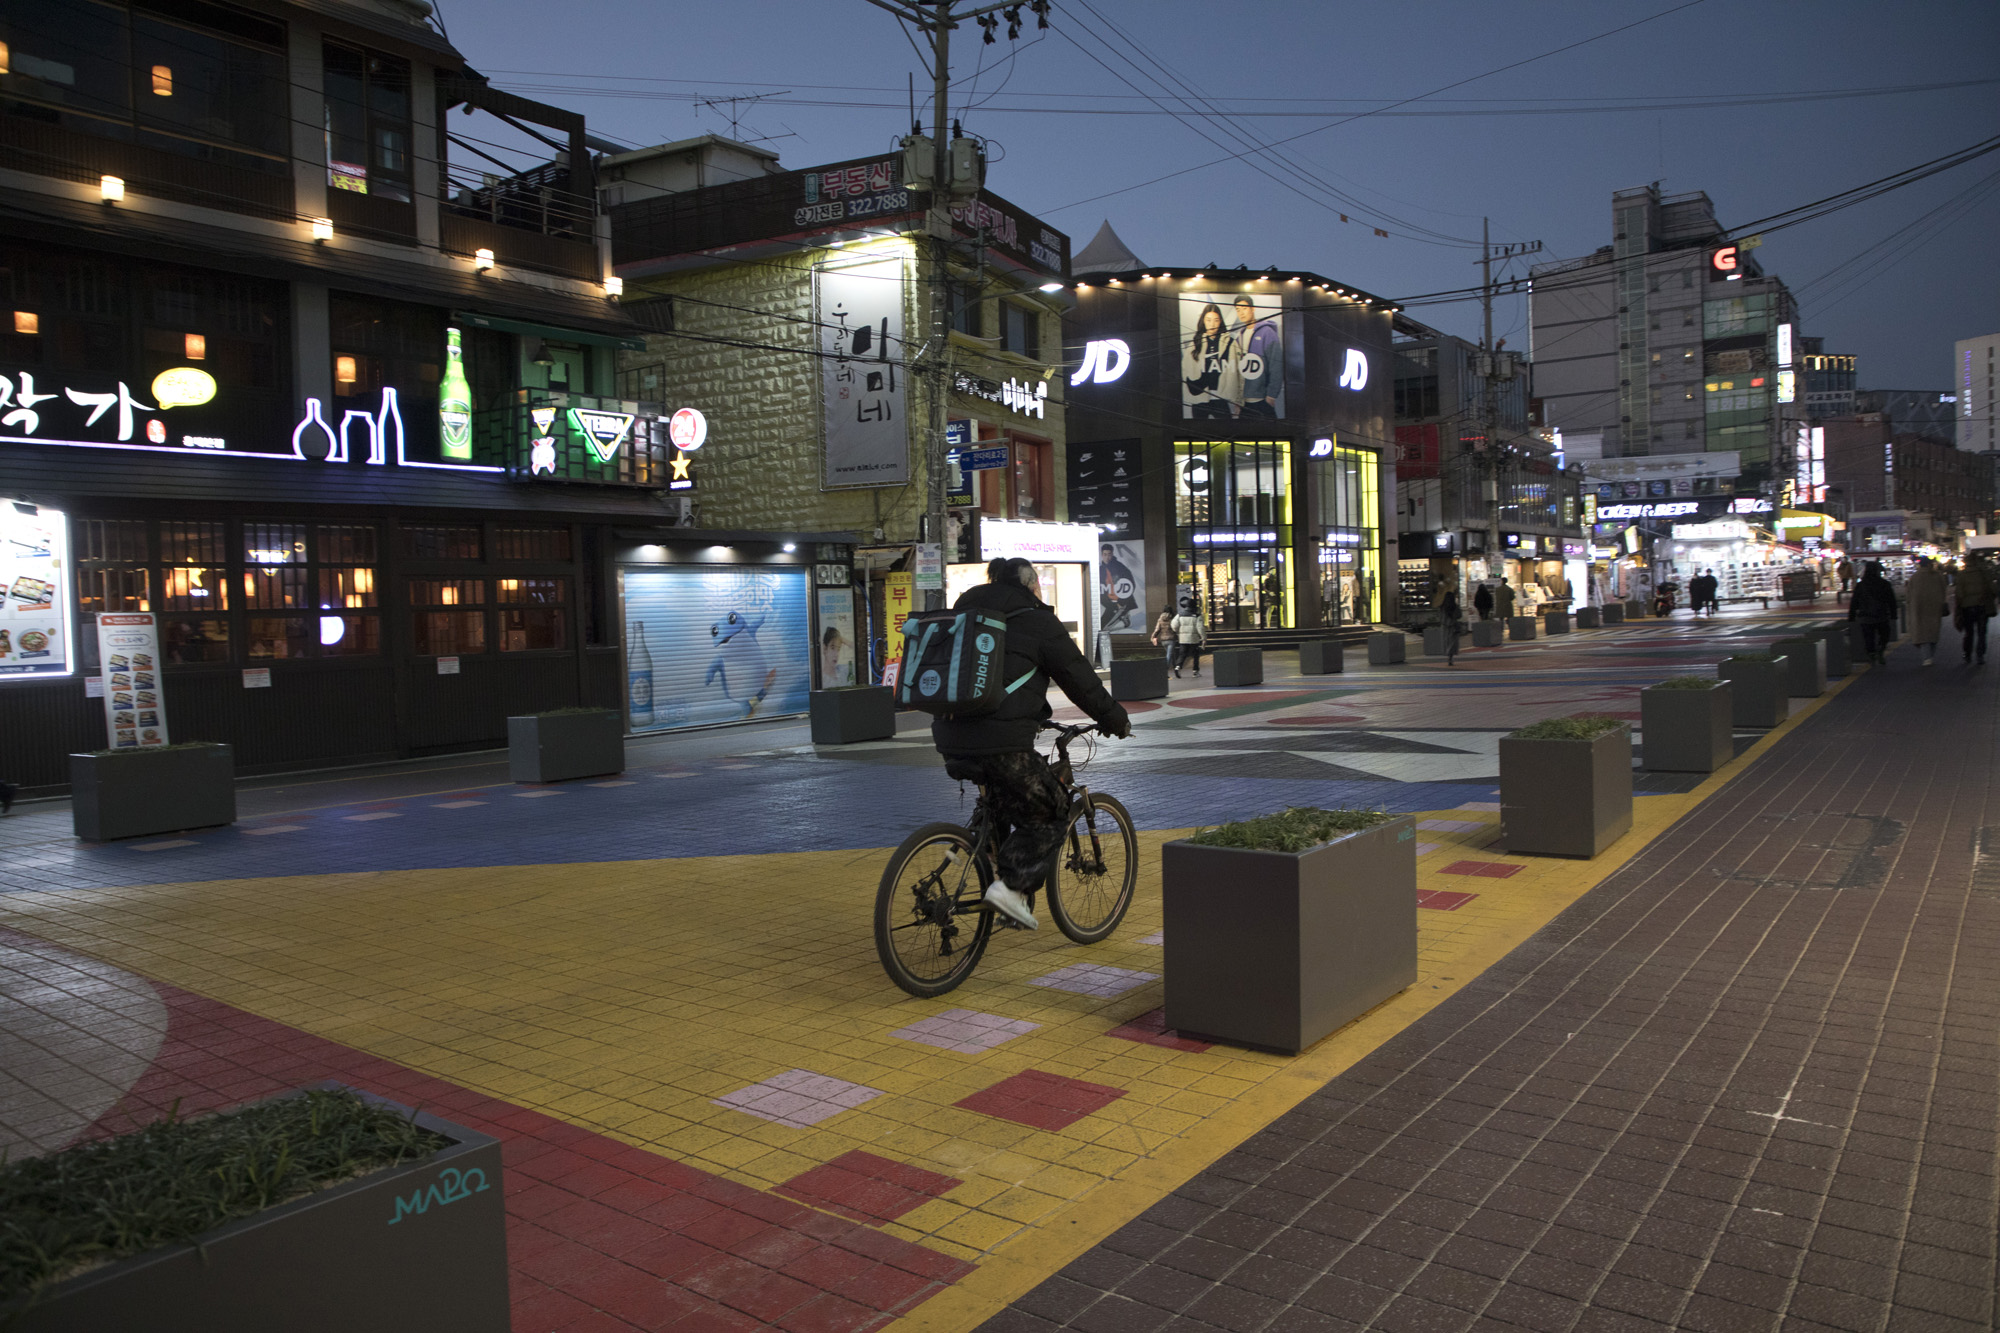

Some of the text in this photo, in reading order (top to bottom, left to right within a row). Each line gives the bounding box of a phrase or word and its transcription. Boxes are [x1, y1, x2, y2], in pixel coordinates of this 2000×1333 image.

[823, 162, 892, 199] 부동산
[794, 192, 908, 226] 상가전문 322.7888
[852, 316, 896, 423] 미미네
[1070, 338, 1131, 387] JD
[1242, 360, 1260, 373] JD
[1339, 348, 1369, 391] JD
[582, 415, 628, 438] TERRA
[673, 415, 695, 437] 24
[1309, 438, 1332, 456] JD
[1654, 502, 1698, 516] BEER
[1116, 583, 1131, 593] JD
[387, 1166, 490, 1226] MAPO
